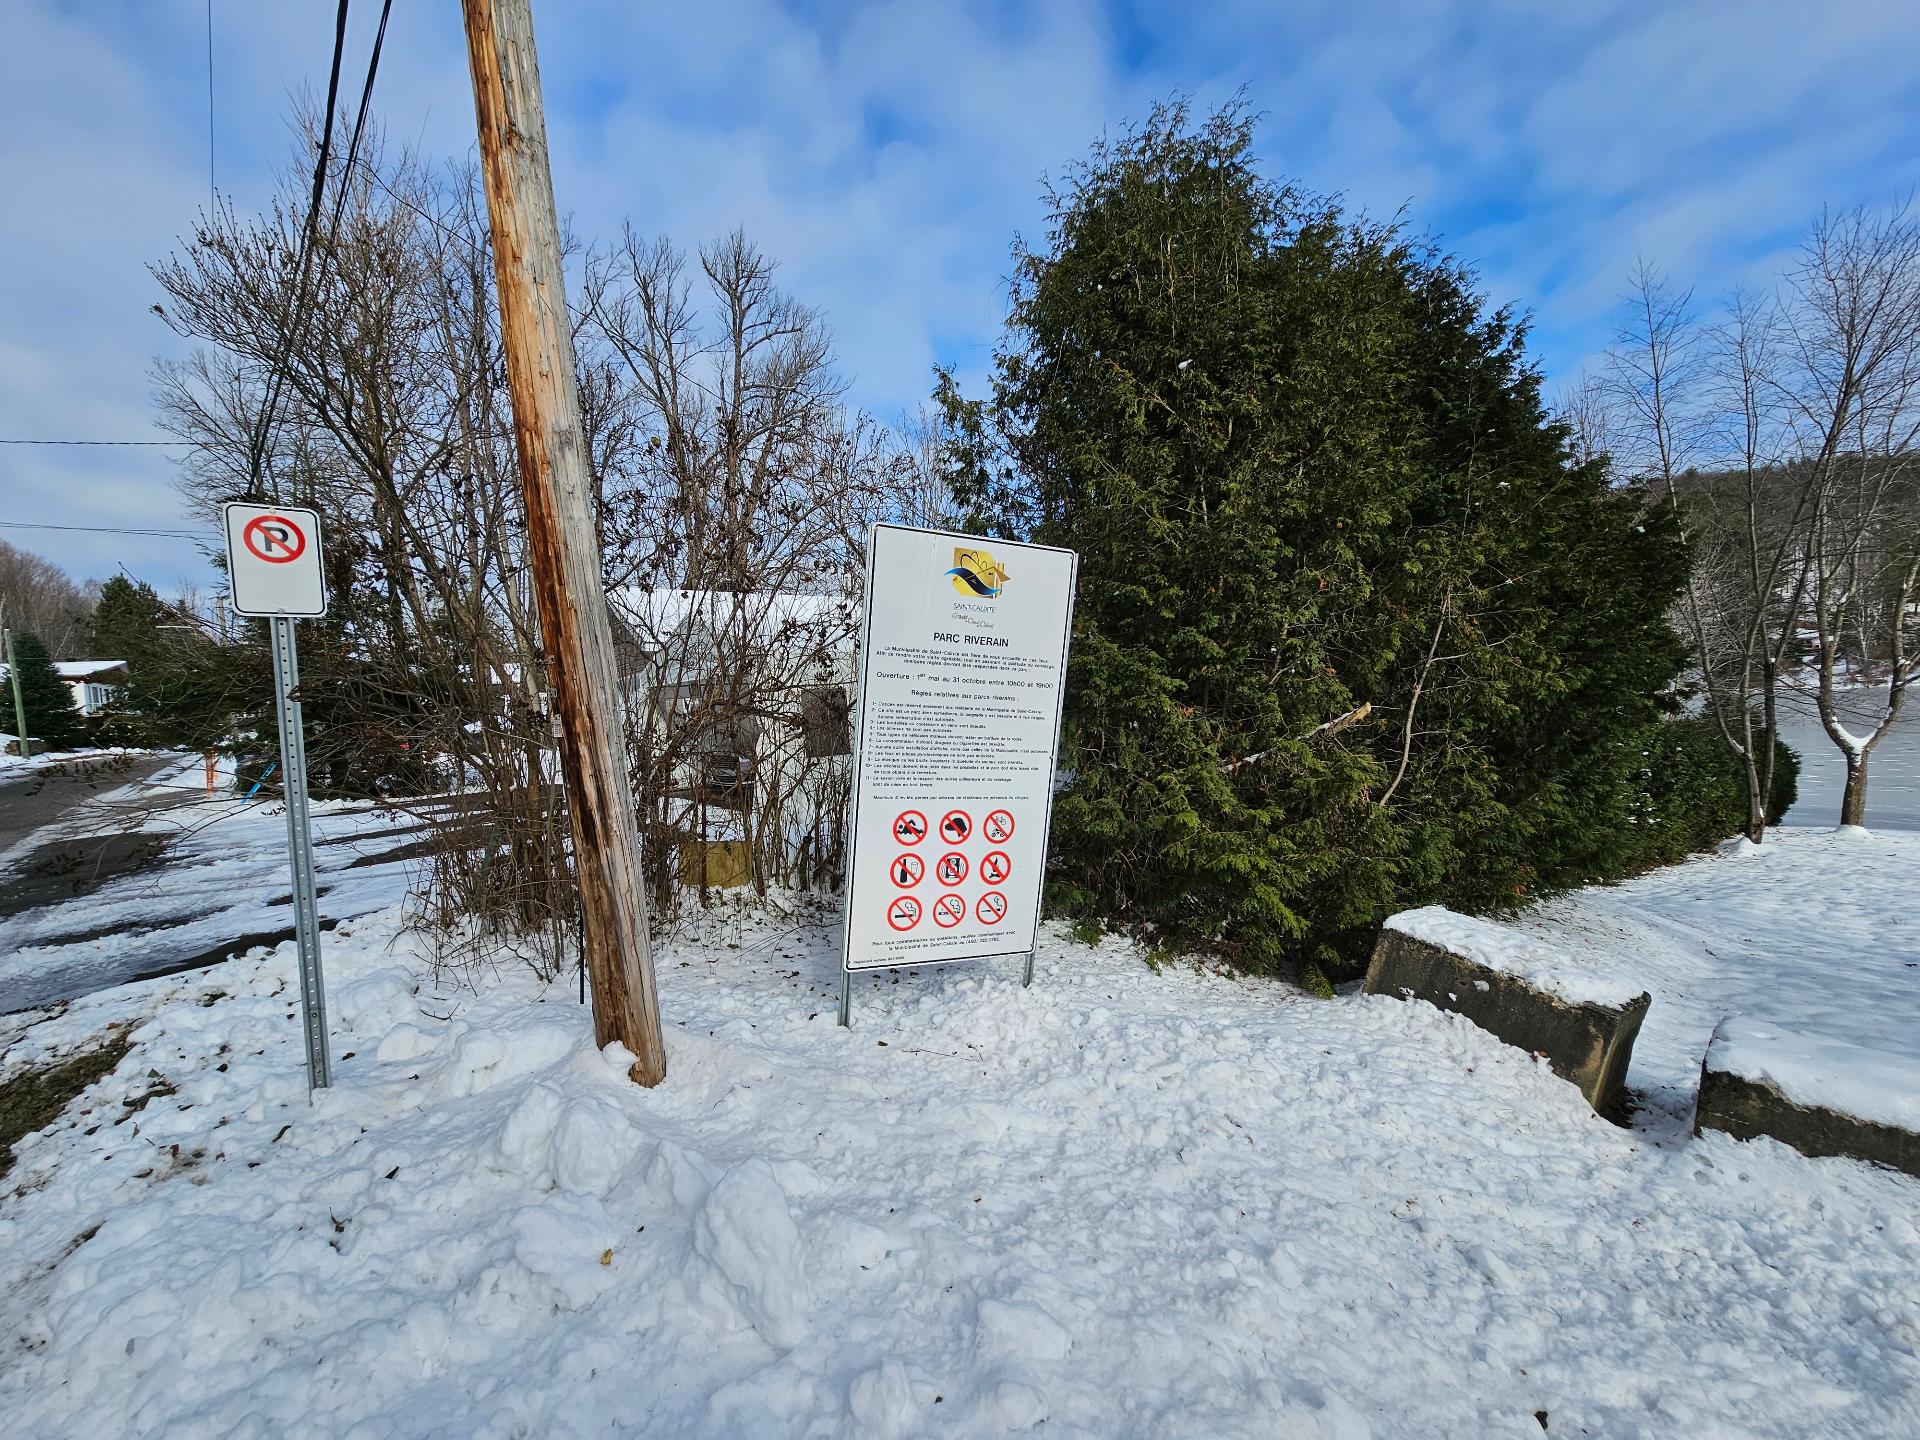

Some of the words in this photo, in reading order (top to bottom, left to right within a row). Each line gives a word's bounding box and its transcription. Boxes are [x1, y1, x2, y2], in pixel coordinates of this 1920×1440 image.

[933, 632, 960, 643] PARC
[964, 634, 1009, 647] RIVERAIN
[875, 671, 910, 680] Ouverture
[910, 689, 932, 698] Règles
